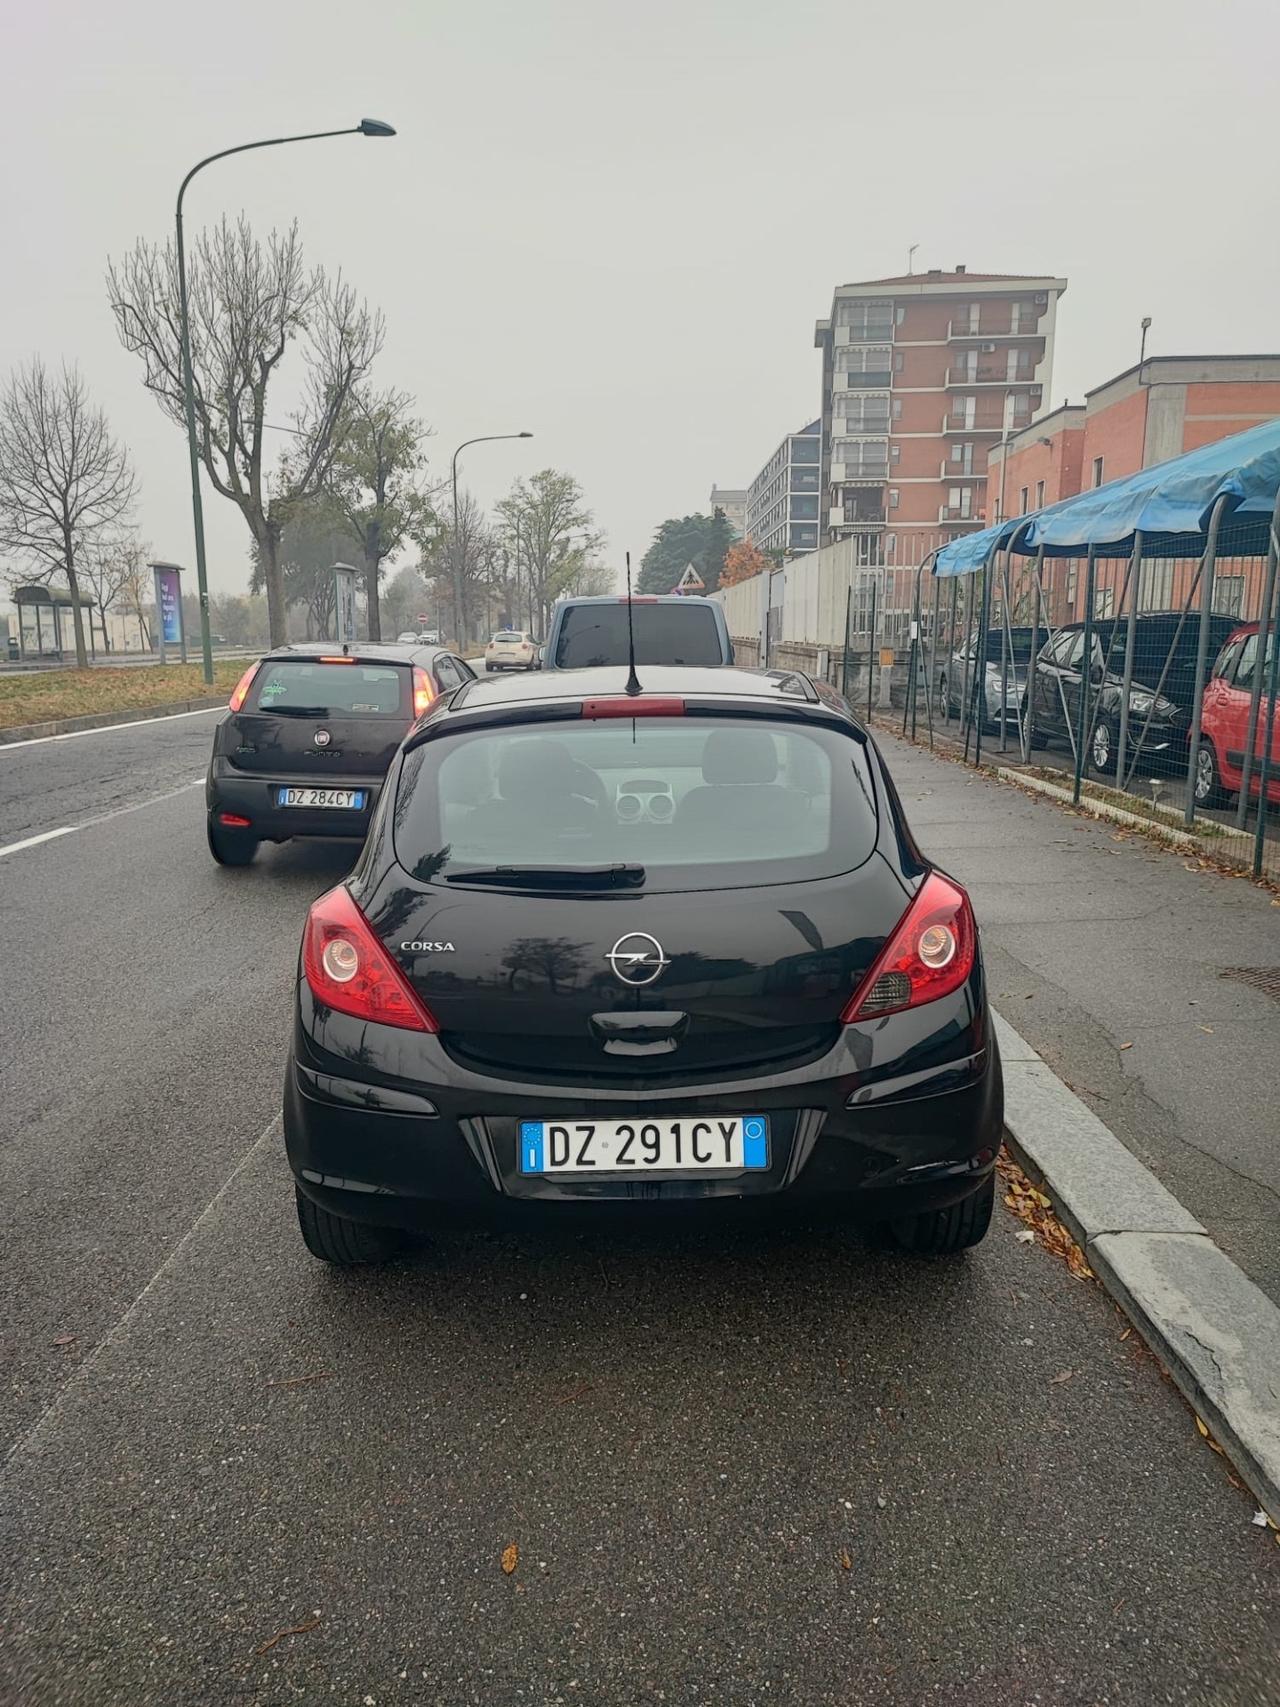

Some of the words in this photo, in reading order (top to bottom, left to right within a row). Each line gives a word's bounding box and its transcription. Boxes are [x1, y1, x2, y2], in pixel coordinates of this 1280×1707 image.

[288, 790, 305, 804] DZ
[310, 791, 353, 806] 284CY
[401, 941, 455, 952] CORSA
[529, 1149, 536, 1168] I
[549, 1125, 596, 1166] DZ
[615, 1122, 737, 1165] 291CY
